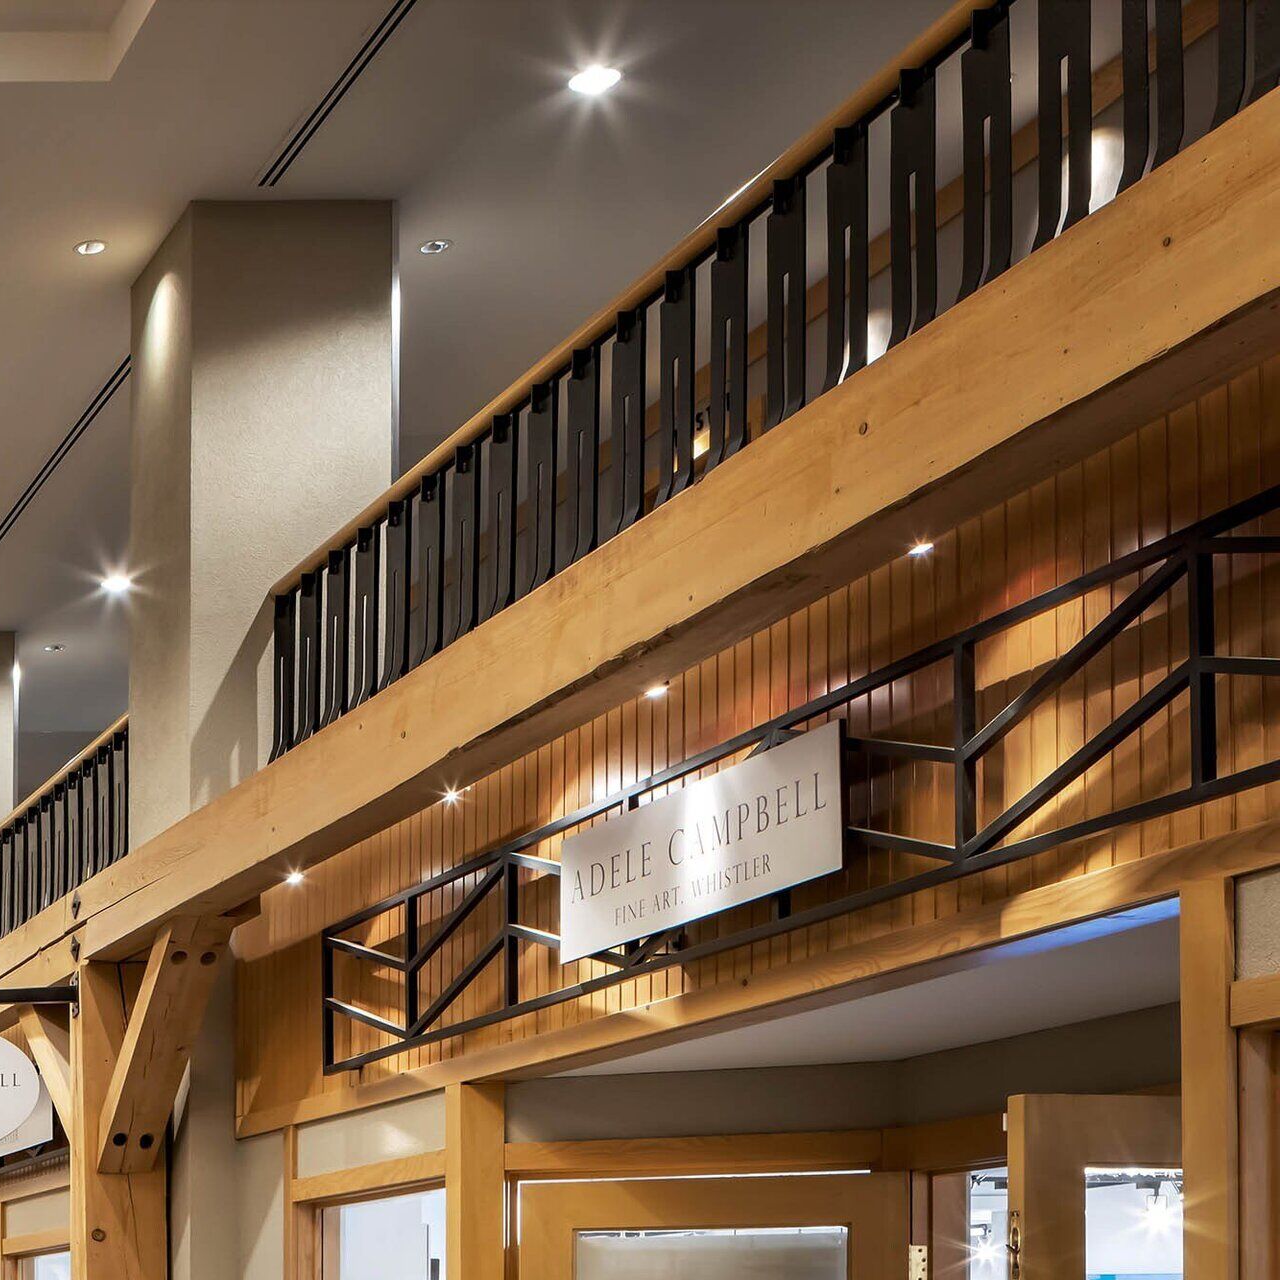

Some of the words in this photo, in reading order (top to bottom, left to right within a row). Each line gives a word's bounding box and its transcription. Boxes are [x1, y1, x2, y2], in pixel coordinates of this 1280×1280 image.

[572, 841, 652, 904] ADELE
[668, 772, 827, 867] CAMPBELL
[614, 898, 647, 927] FINE
[691, 853, 772, 899] WHISTLER
